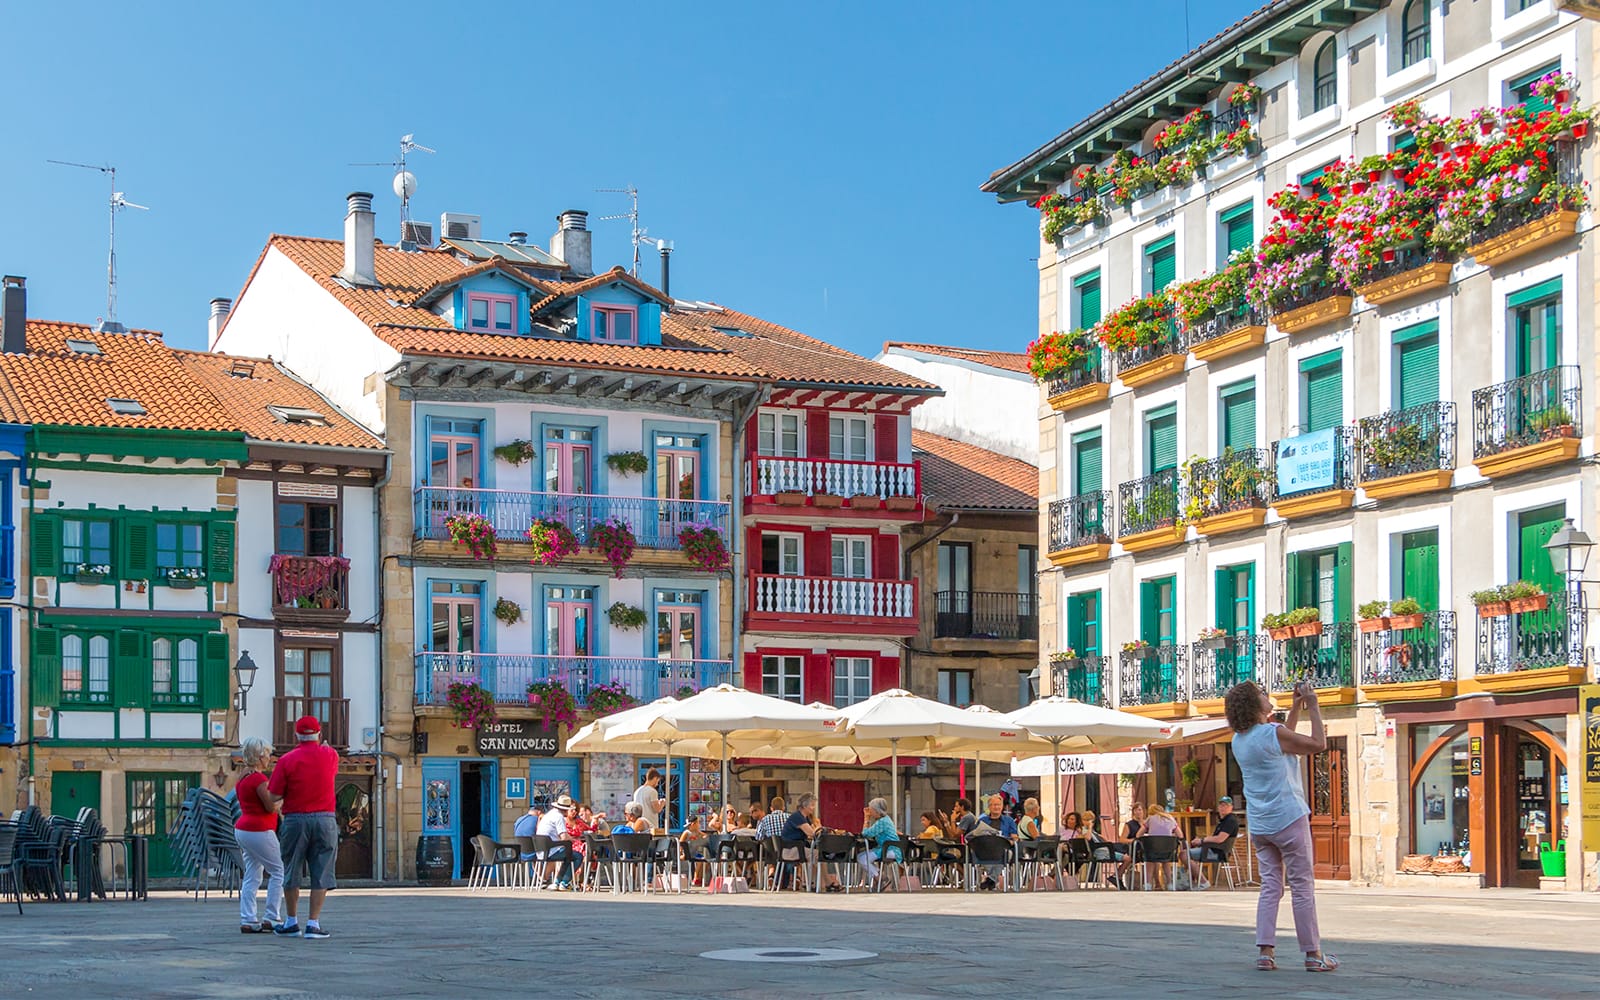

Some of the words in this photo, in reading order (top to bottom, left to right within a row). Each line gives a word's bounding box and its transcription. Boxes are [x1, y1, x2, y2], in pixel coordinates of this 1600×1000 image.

[1301, 445, 1309, 455] SE
[1311, 441, 1329, 453] VENDE
[485, 723, 523, 733] HOTEL
[480, 738, 506, 750] SAN
[509, 738, 556, 750] NICOLAS
[1057, 758, 1084, 772] OPARA
[1472, 758, 1480, 769] 6
[511, 782, 520, 793] H
